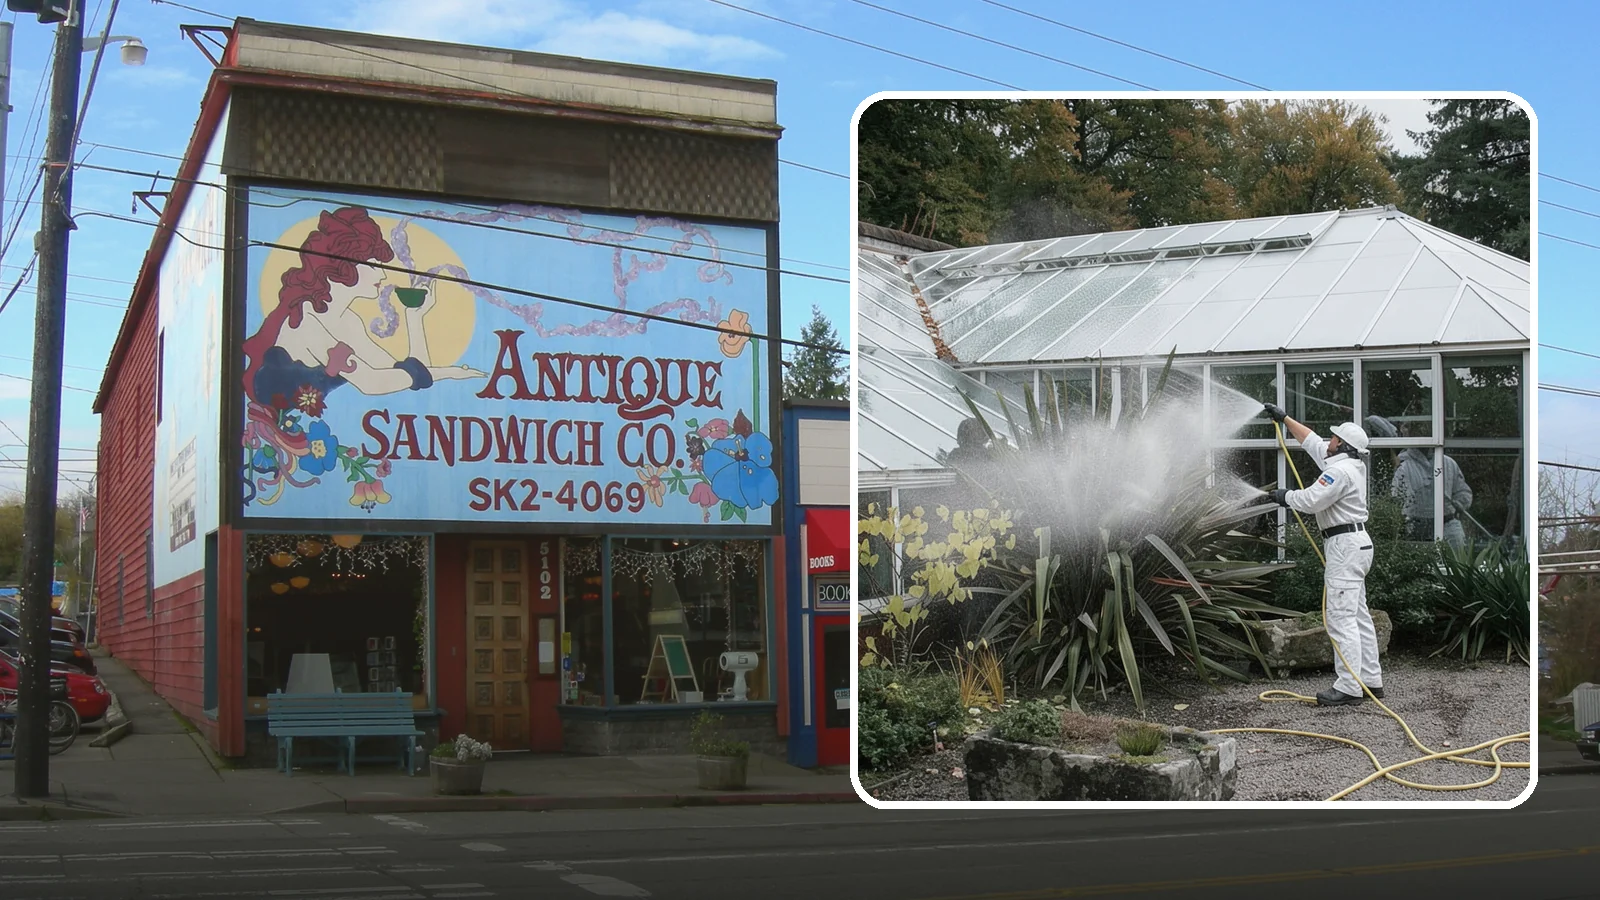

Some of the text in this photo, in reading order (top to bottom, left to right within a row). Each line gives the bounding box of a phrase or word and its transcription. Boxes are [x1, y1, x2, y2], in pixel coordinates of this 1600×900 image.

[475, 329, 724, 421] ANTIQUE
[361, 408, 685, 469] SANDWICH CO.
[469, 477, 645, 513] SK2-4069
[540, 542, 551, 599] 5102
[809, 555, 835, 569] BOOKS
